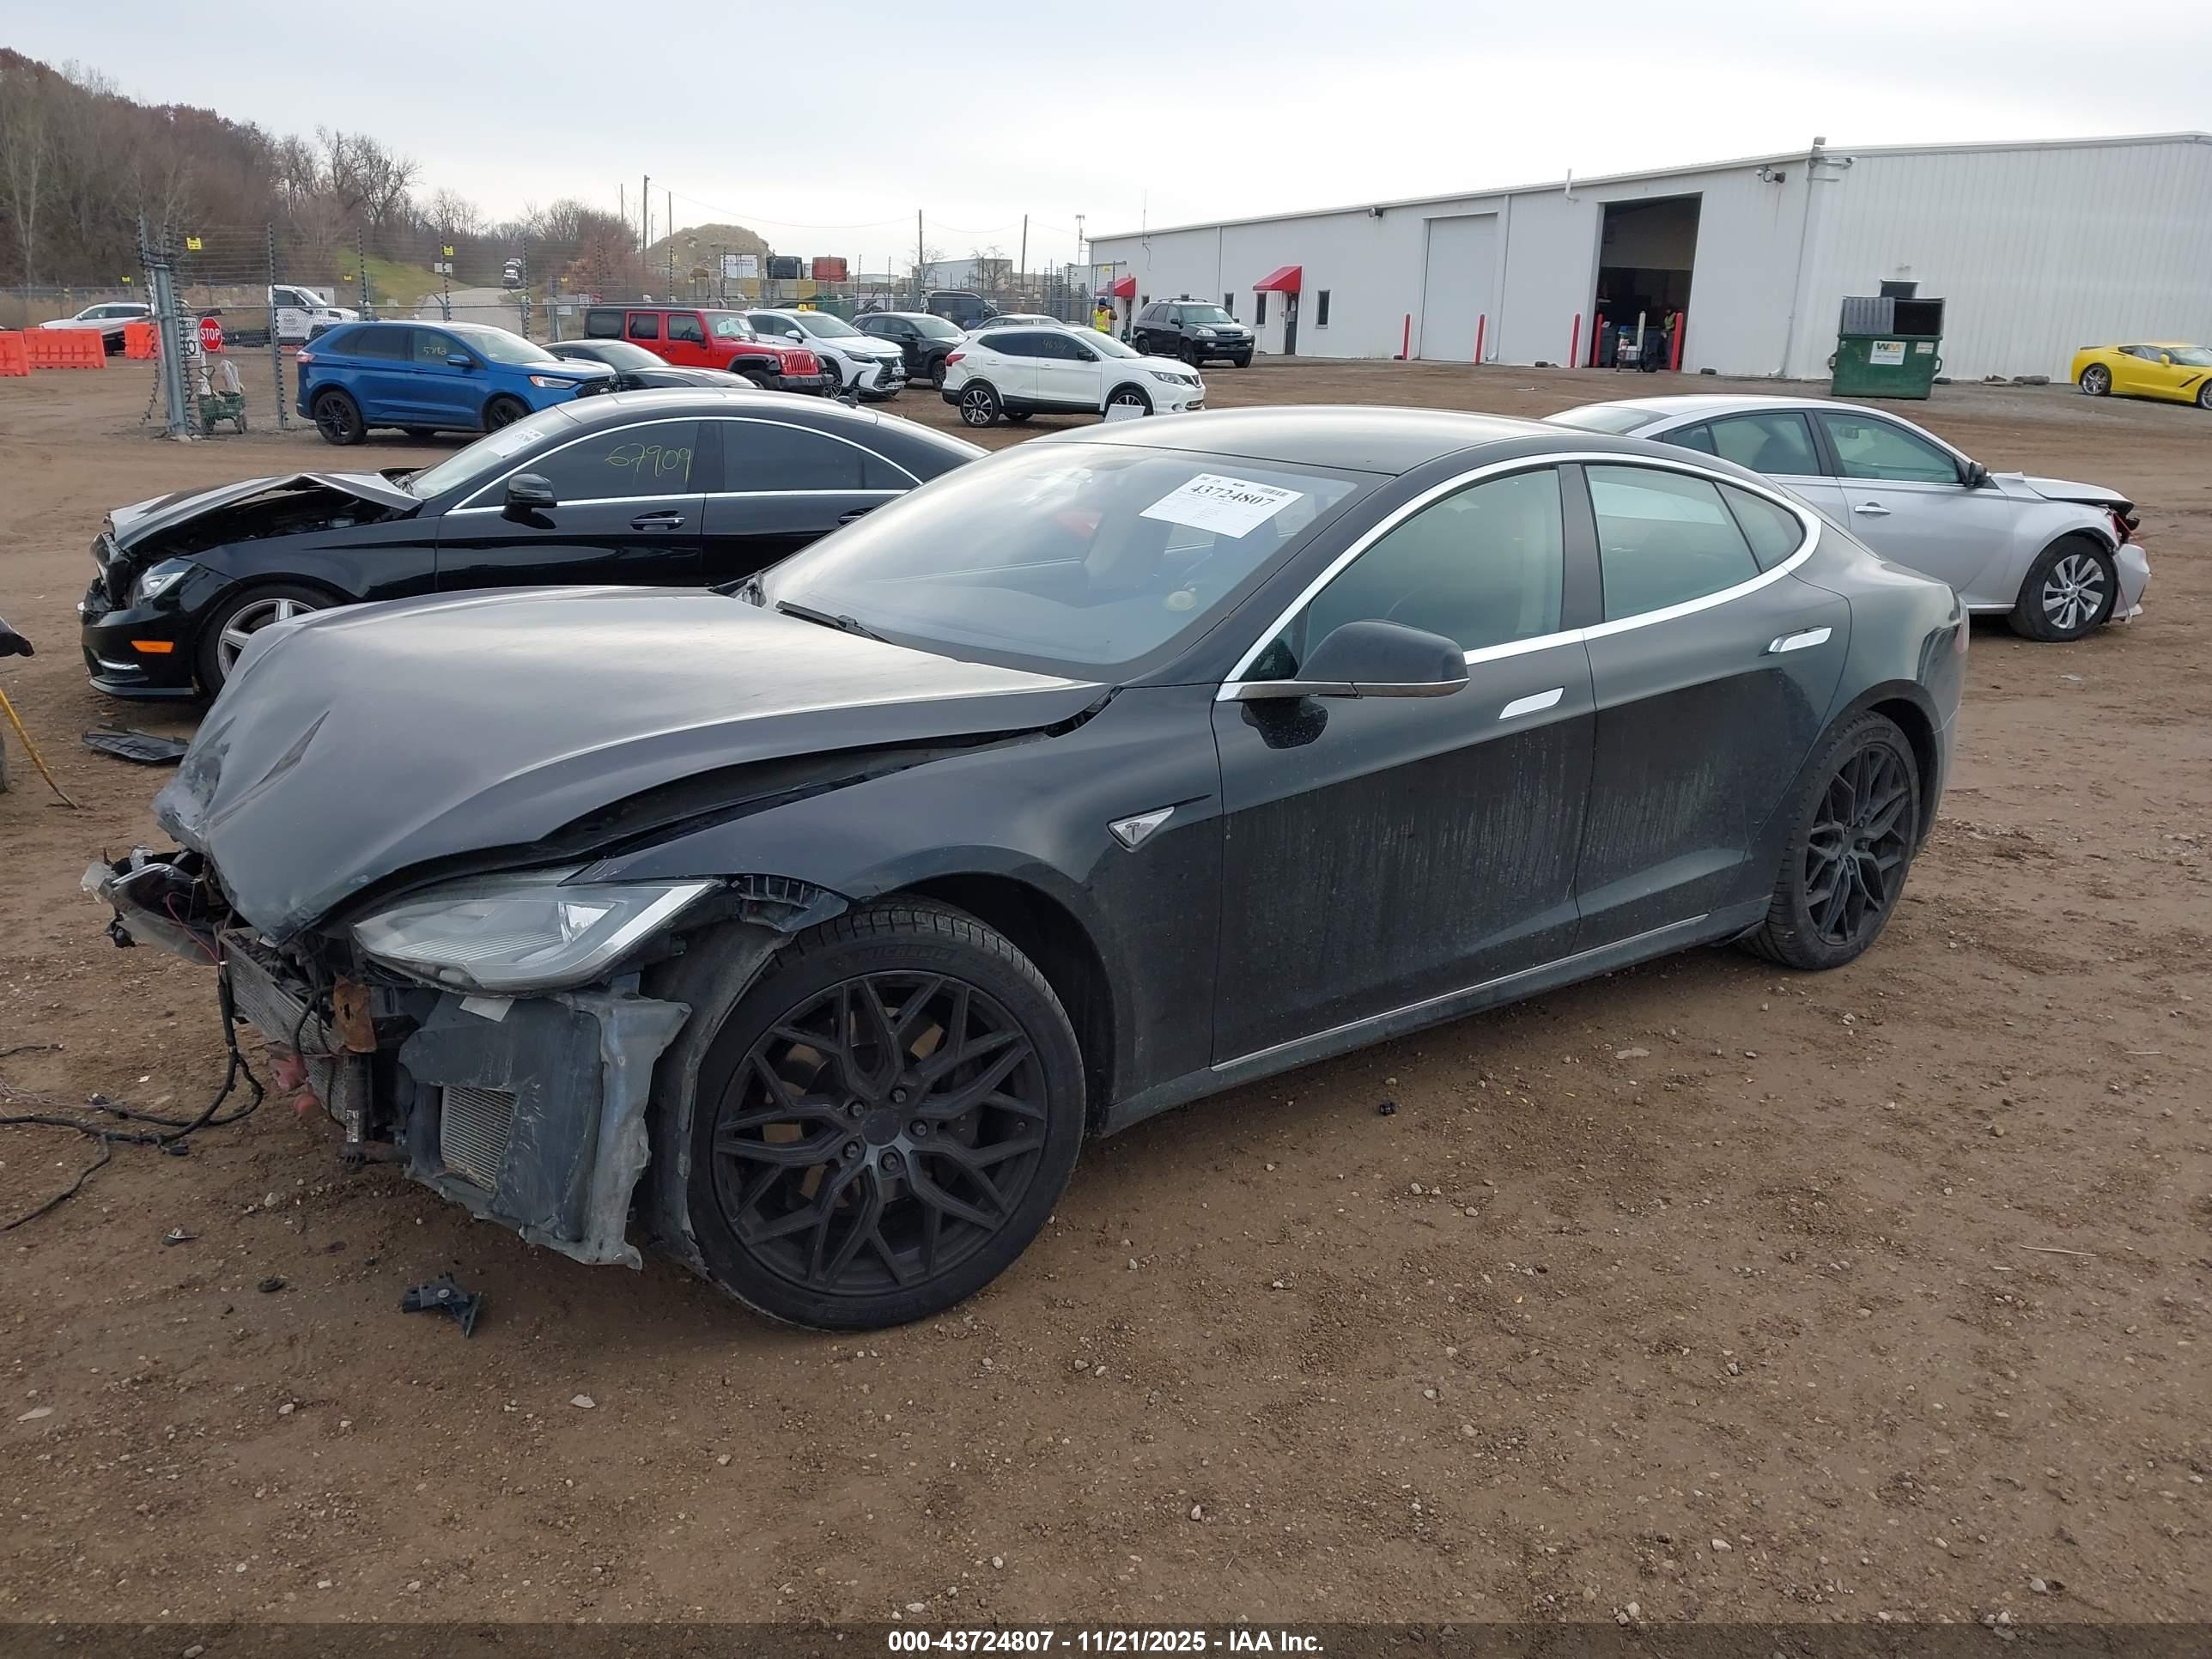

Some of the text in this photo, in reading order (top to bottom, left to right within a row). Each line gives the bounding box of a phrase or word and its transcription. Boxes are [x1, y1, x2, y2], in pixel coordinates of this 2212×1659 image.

[200, 328, 221, 341] STOP
[605, 443, 691, 483] 67909
[1190, 484, 1276, 507] 43724807
